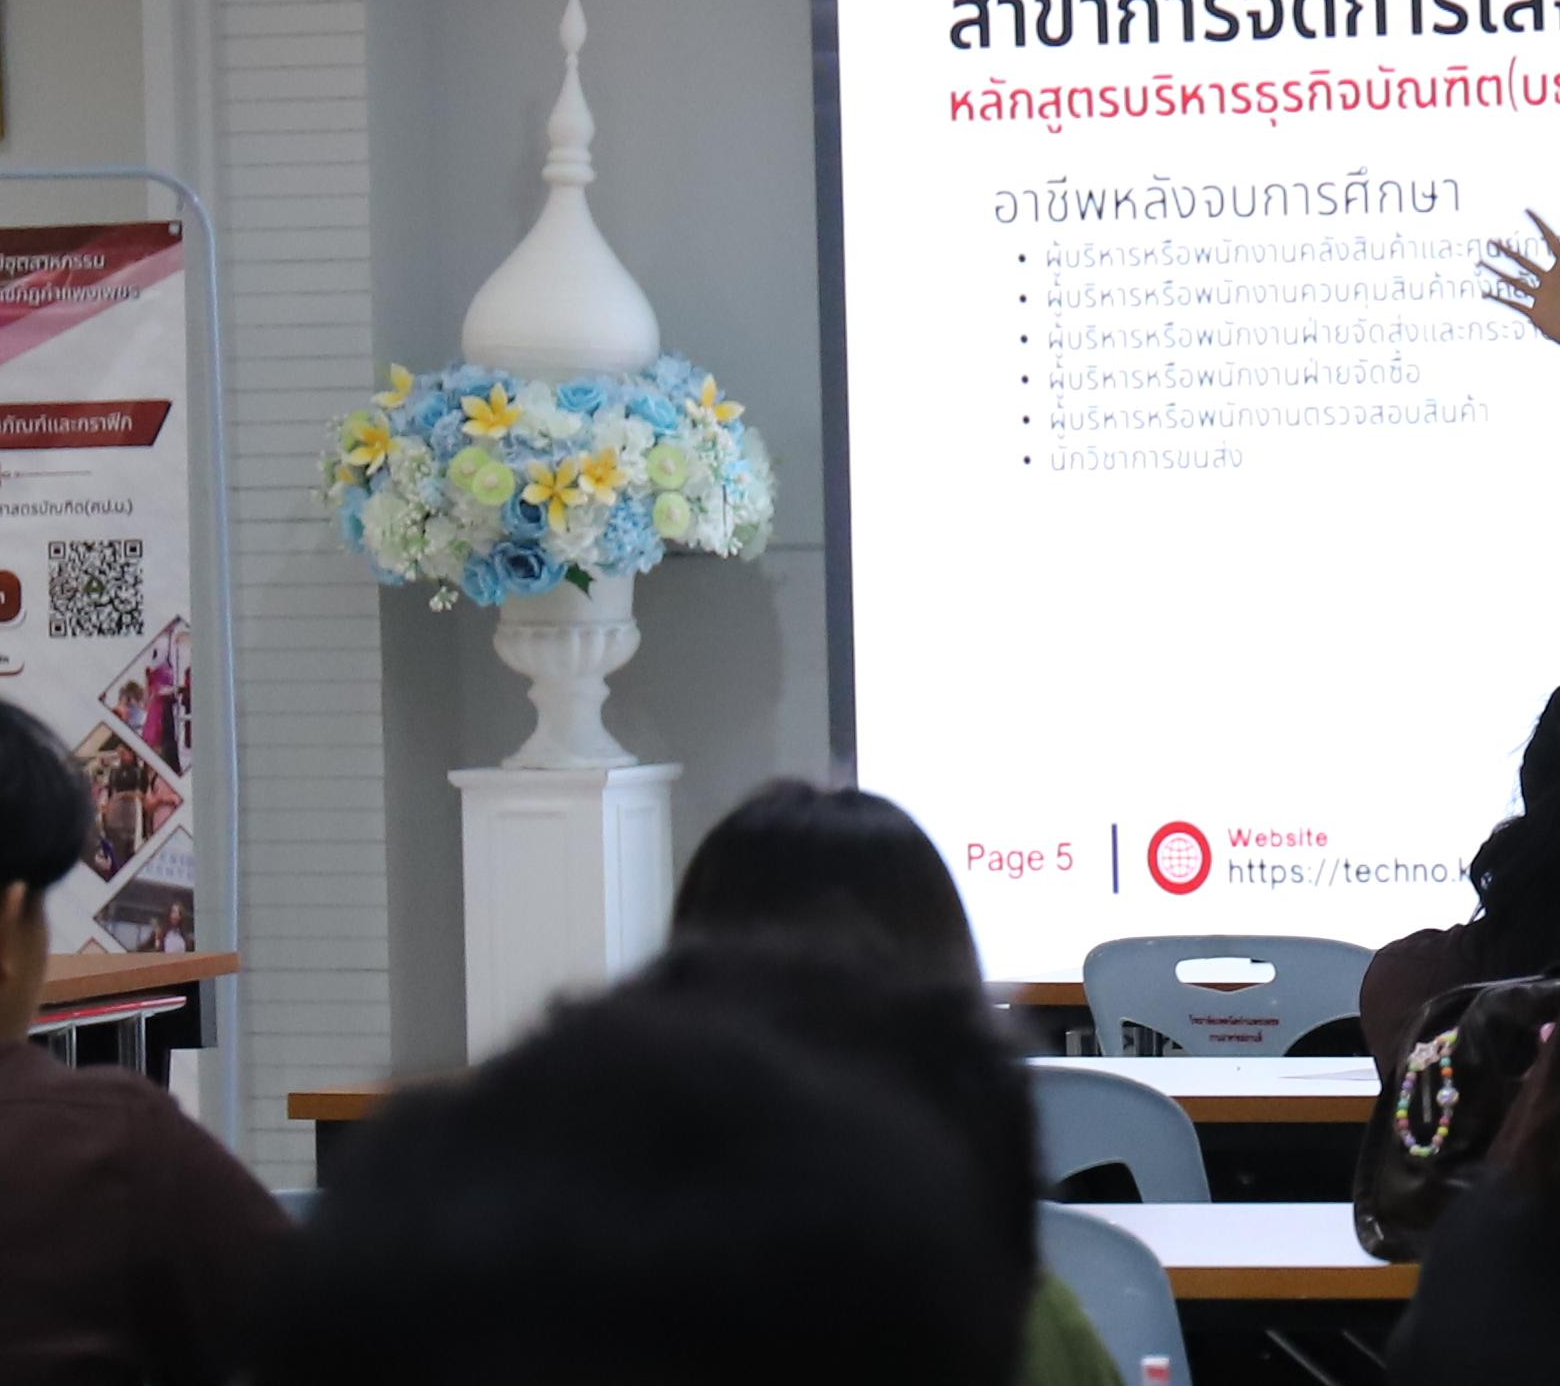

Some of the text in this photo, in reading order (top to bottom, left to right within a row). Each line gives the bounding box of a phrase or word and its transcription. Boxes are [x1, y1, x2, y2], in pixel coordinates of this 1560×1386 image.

[994, 166, 1460, 224] อาชีพหลังจบการศึกษา
[1049, 350, 1421, 399] ผู้บริหารหรือพนักงานฝ่ายจัดซื้อ
[1050, 395, 1490, 439] ผู้บริหารหรือพนักงานตรวจสอบสินค้า
[1050, 441, 1244, 471] นักวิชาการขนส่ง
[1227, 827, 1329, 849] Website
[967, 842, 1074, 879] Page 5
